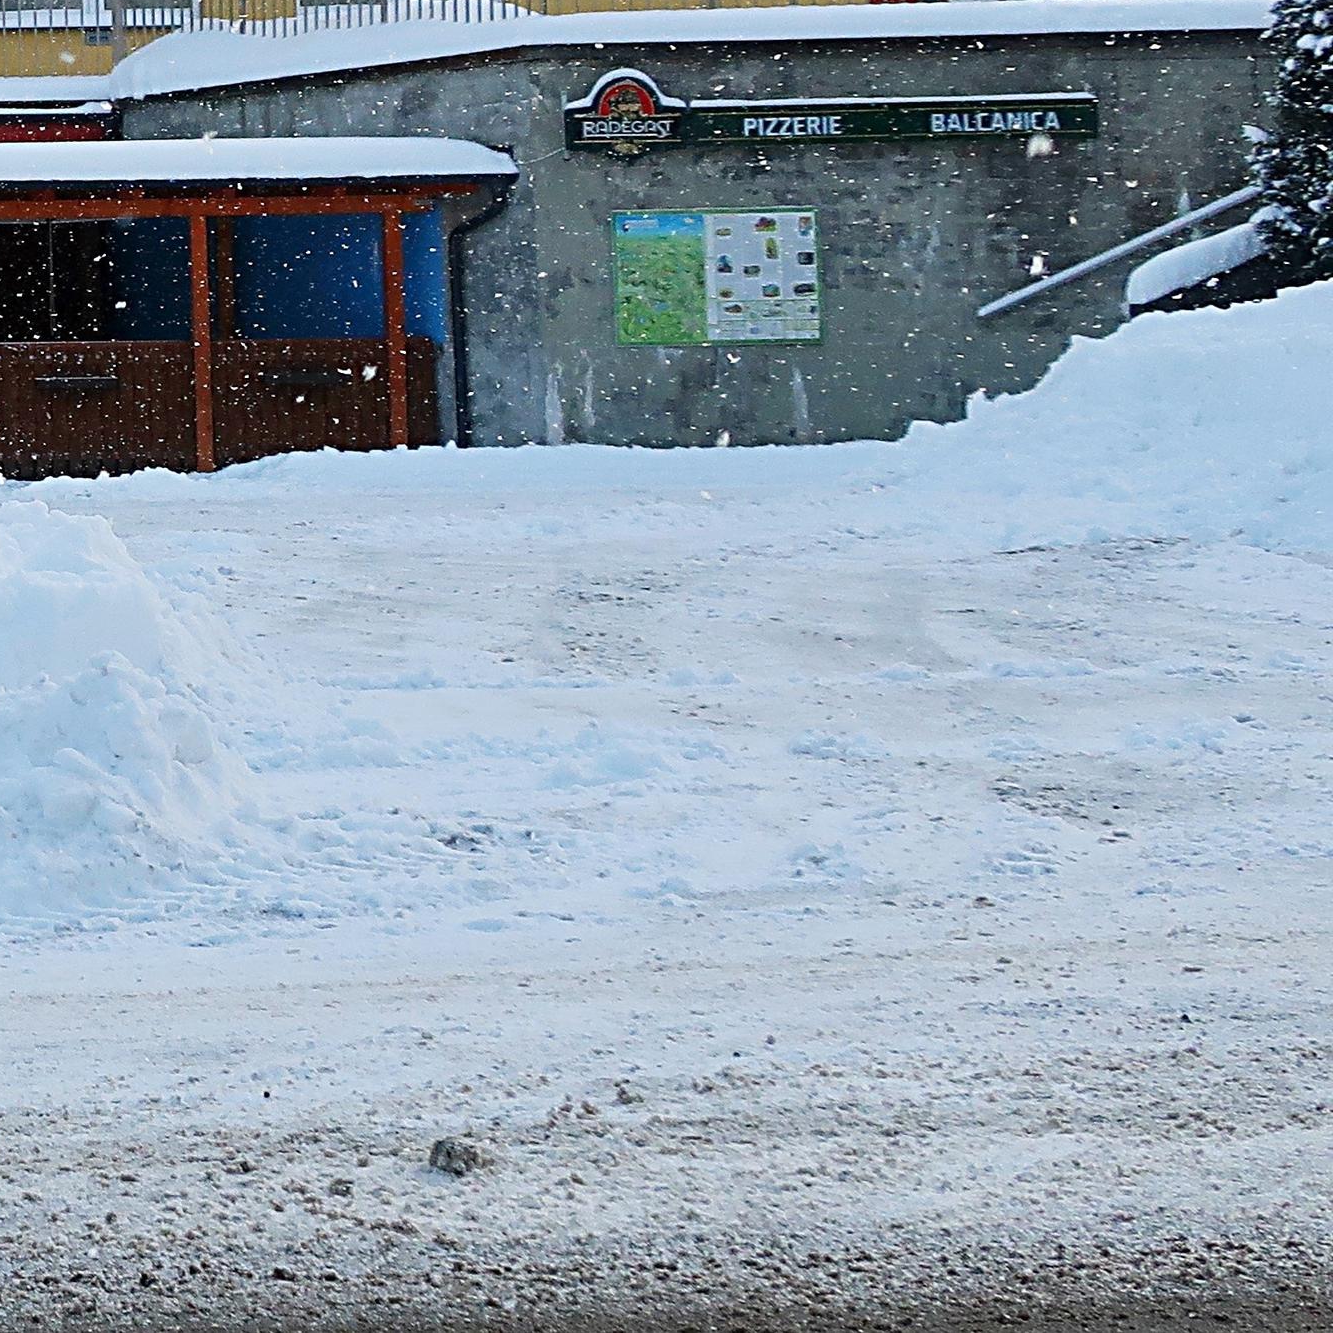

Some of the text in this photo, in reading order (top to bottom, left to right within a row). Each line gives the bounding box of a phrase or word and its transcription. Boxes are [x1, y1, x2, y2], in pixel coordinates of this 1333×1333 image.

[582, 119, 675, 139] RADEGAST
[743, 111, 1061, 137] PIZZERIE BALCANICA
